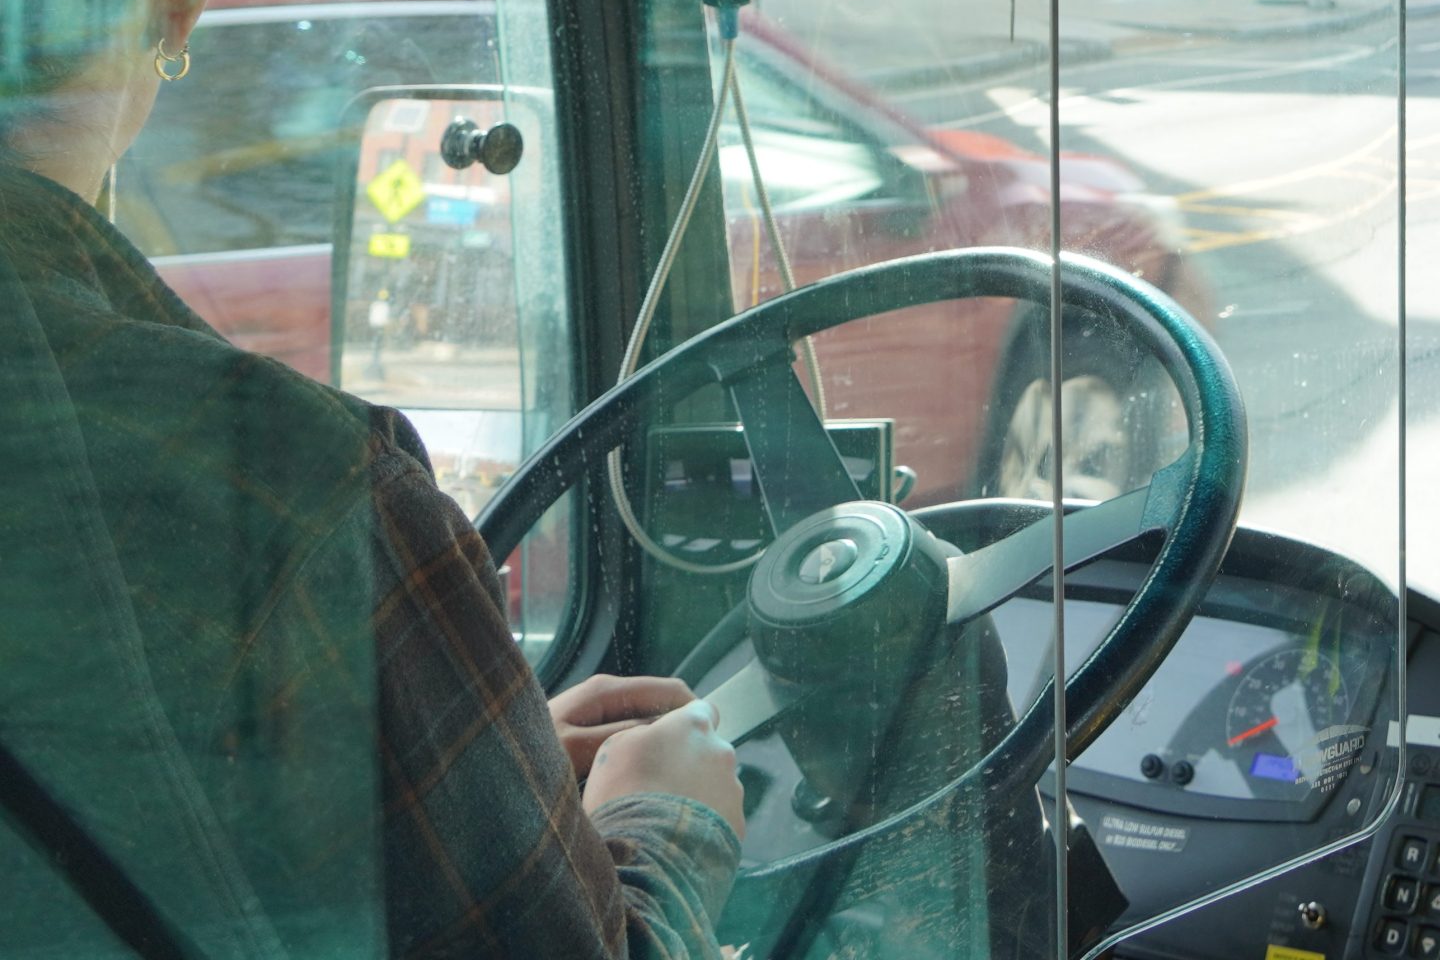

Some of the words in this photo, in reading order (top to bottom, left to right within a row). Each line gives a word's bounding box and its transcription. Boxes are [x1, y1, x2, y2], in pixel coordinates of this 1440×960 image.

[1406, 846, 1420, 862] R
[1396, 887, 1410, 904] N
[1386, 929, 1399, 945] D
